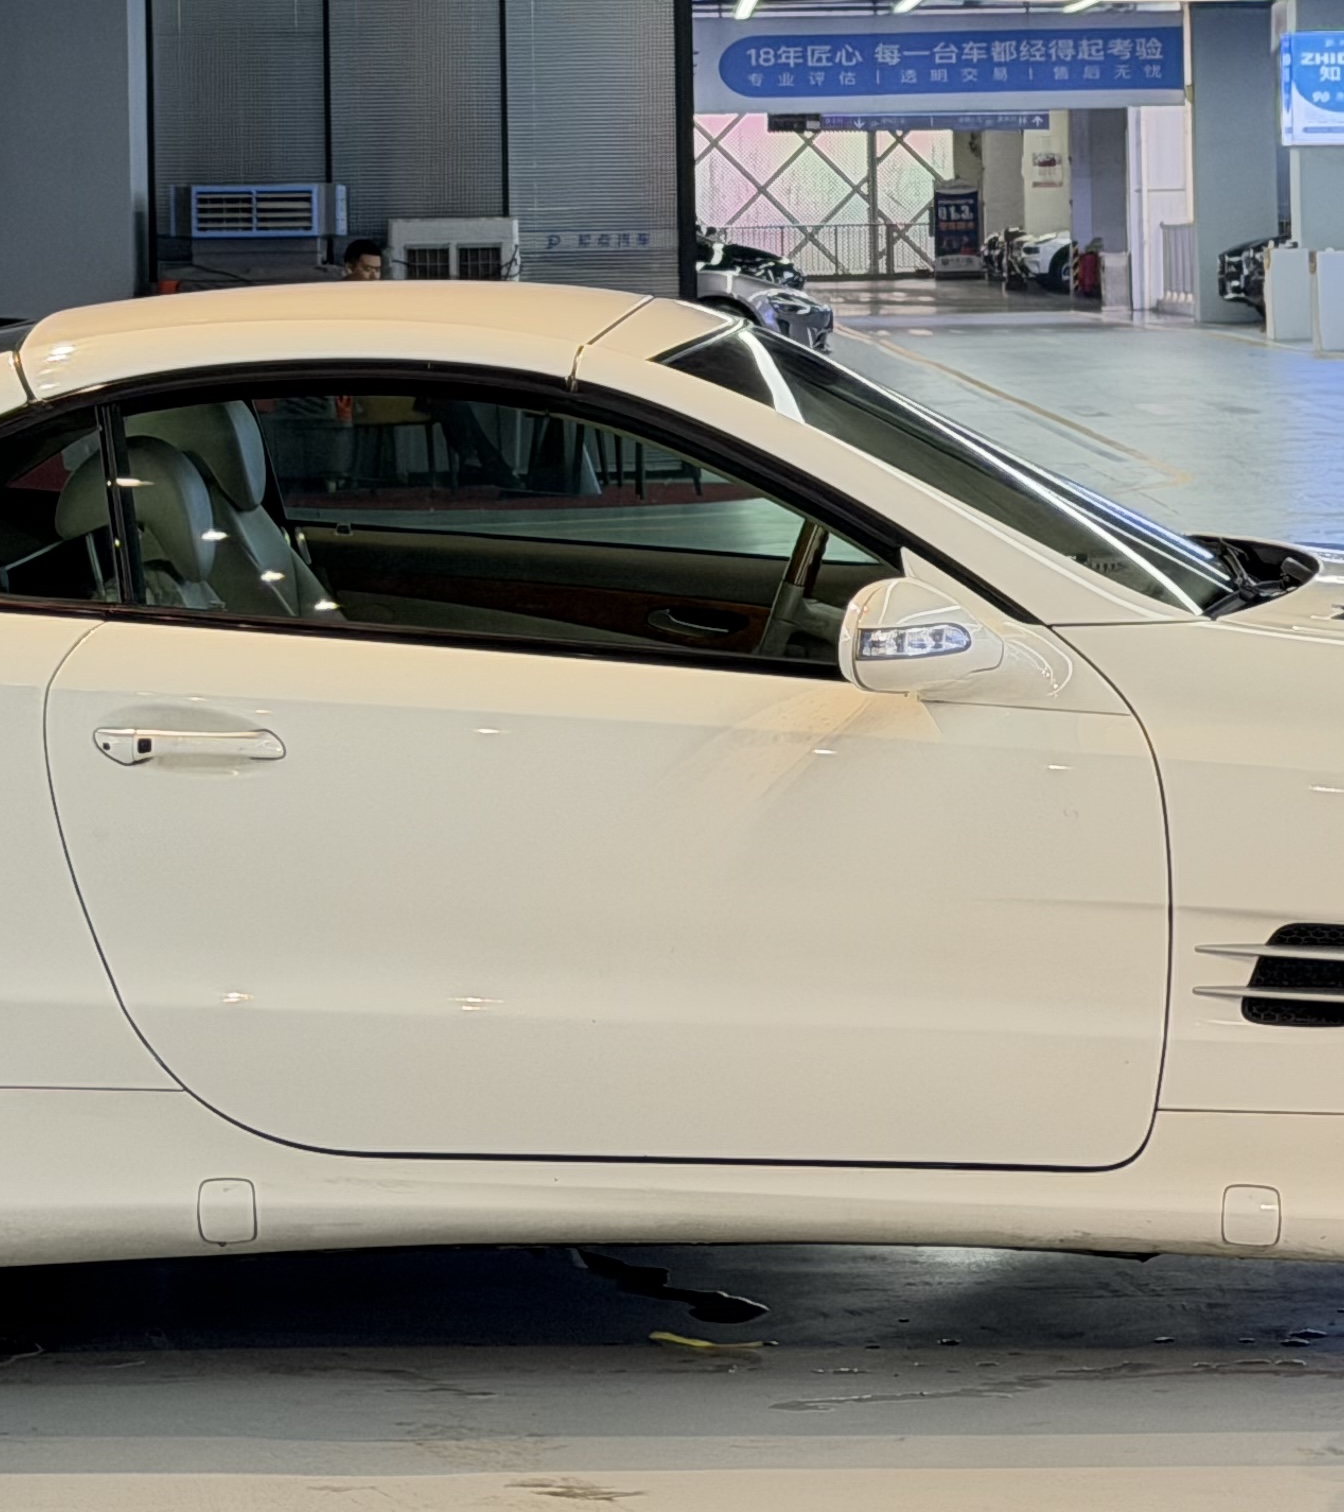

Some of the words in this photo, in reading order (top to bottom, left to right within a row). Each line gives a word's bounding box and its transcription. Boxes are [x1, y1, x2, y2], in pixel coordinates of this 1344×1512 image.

[746, 44, 862, 68] 18年匠心
[875, 37, 1163, 68] 每一台车都经得起考验
[748, 72, 856, 87] 专业评估
[901, 66, 1008, 84] 透明交易
[1053, 64, 1163, 81] 售后无忧
